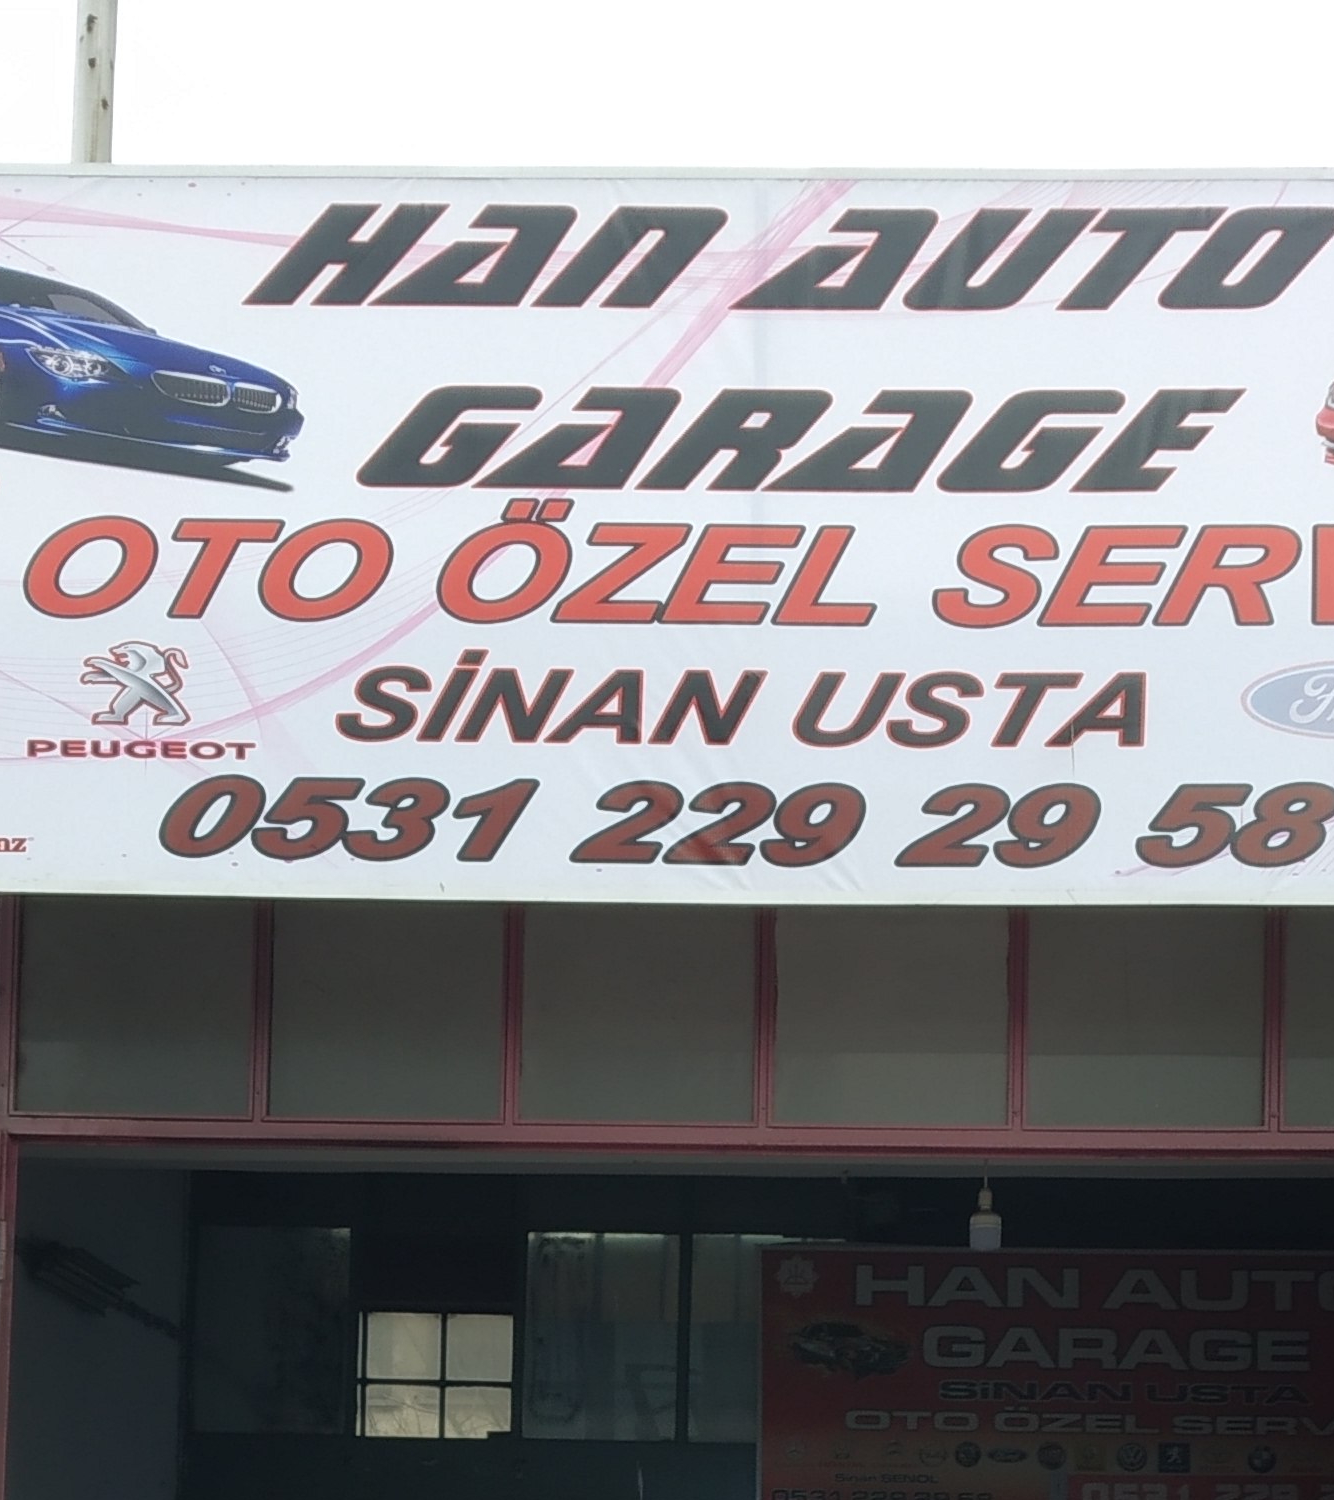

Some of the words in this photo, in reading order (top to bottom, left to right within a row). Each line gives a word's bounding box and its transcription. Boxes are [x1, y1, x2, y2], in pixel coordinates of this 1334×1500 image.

[356, 385, 1247, 493] GARAGE
[23, 515, 394, 623] OTO
[436, 498, 877, 626] ÖZEL
[335, 649, 768, 746] SİNAN
[792, 671, 1148, 748] USTA
[27, 740, 256, 760] PEUGEOT
[158, 774, 541, 862] 0531
[568, 781, 867, 867] 229
[894, 782, 1102, 869] 29
[855, 1263, 1080, 1309] HAN
[923, 1324, 1311, 1373] GARAGE
[1146, 1382, 1314, 1406] USTA
[845, 1409, 979, 1432] OTO
[994, 1406, 1159, 1435] ÖZEL
